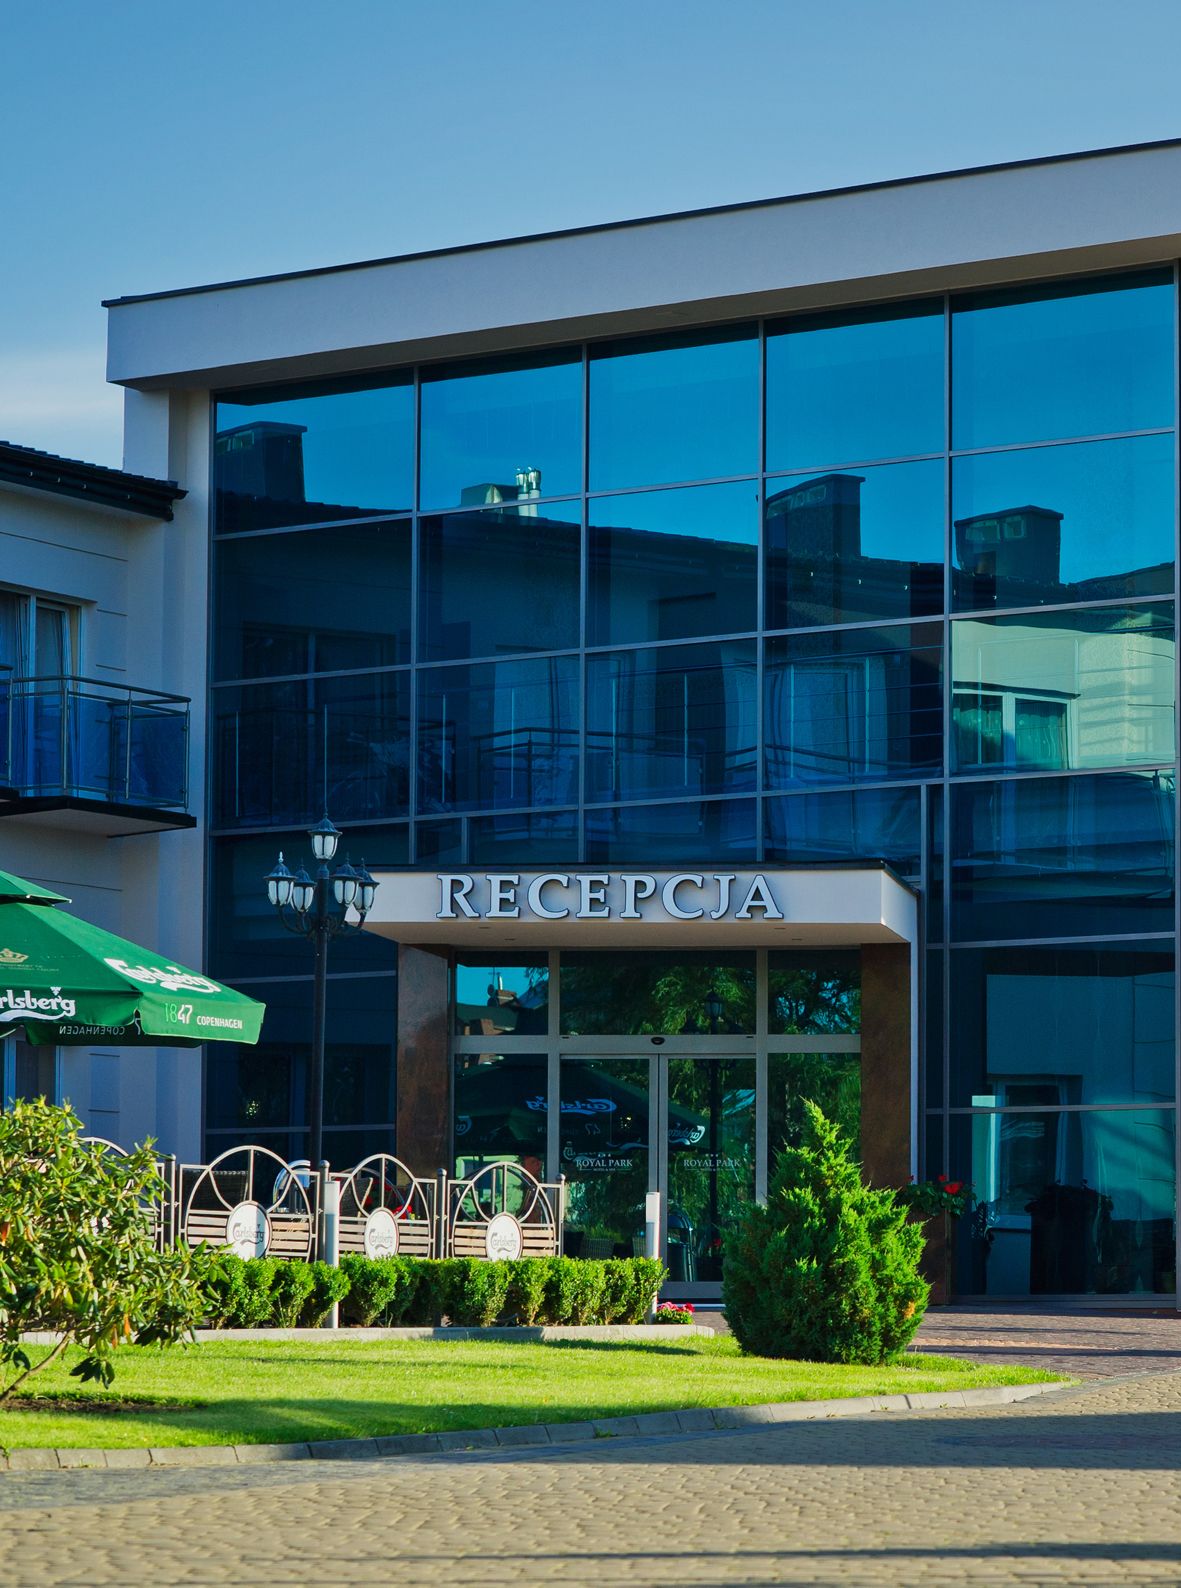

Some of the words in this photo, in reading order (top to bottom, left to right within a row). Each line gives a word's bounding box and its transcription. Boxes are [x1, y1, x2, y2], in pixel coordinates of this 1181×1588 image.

[435, 873, 785, 920] RECEPCJA
[0, 986, 76, 1021] rlsberg
[164, 1003, 193, 1025] 1847
[196, 1015, 243, 1030] COPENHAGEN
[576, 1159, 606, 1167] ROYAL
[608, 1159, 633, 1167] PARK
[683, 1159, 715, 1167] ROYAL
[716, 1159, 741, 1167] PARK
